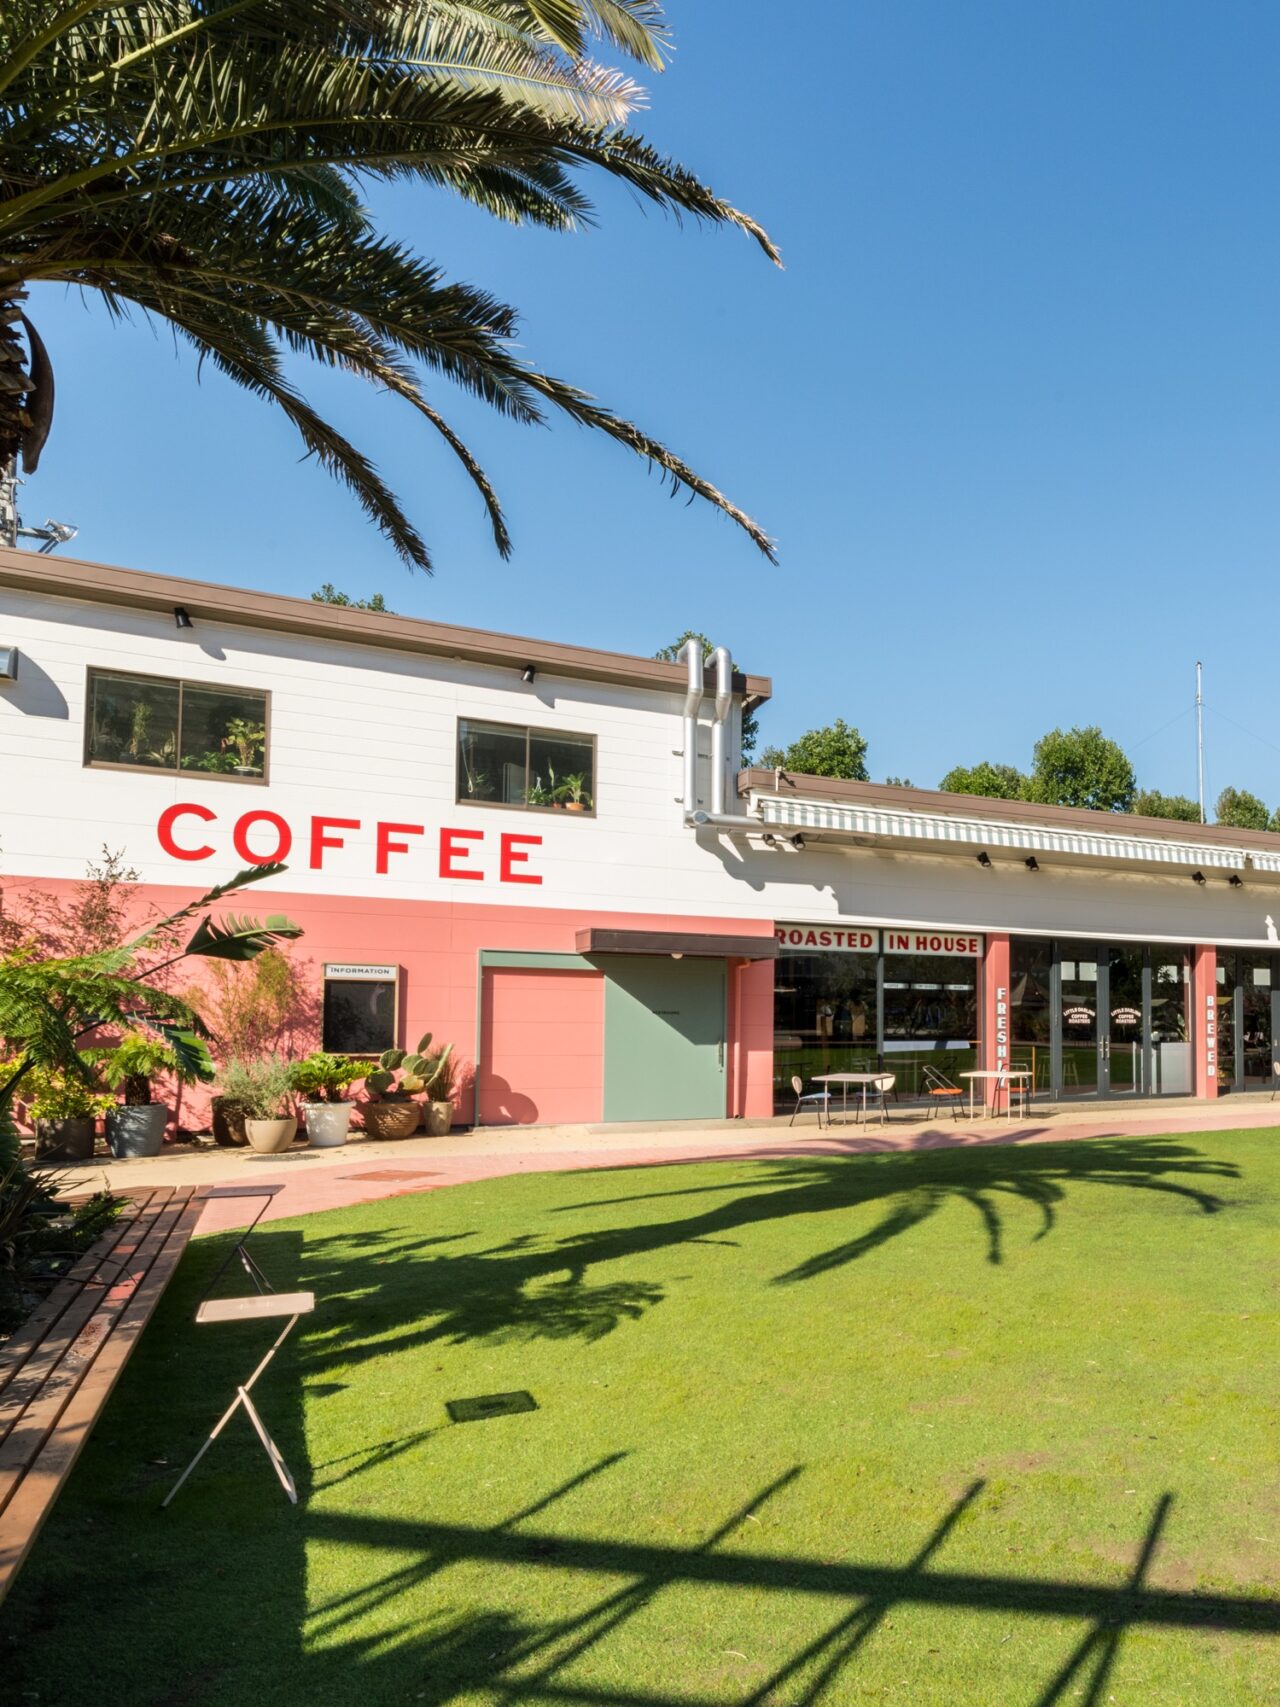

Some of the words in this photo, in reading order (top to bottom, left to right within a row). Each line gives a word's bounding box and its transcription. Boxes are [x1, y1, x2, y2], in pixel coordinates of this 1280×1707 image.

[157, 803, 543, 885] COFFEE
[775, 928, 873, 948] ROASTED
[889, 934, 909, 950] IN
[916, 935, 978, 952] HOUSE
[330, 967, 390, 975] INFORMATION
[1207, 995, 1216, 1077] BREWED
